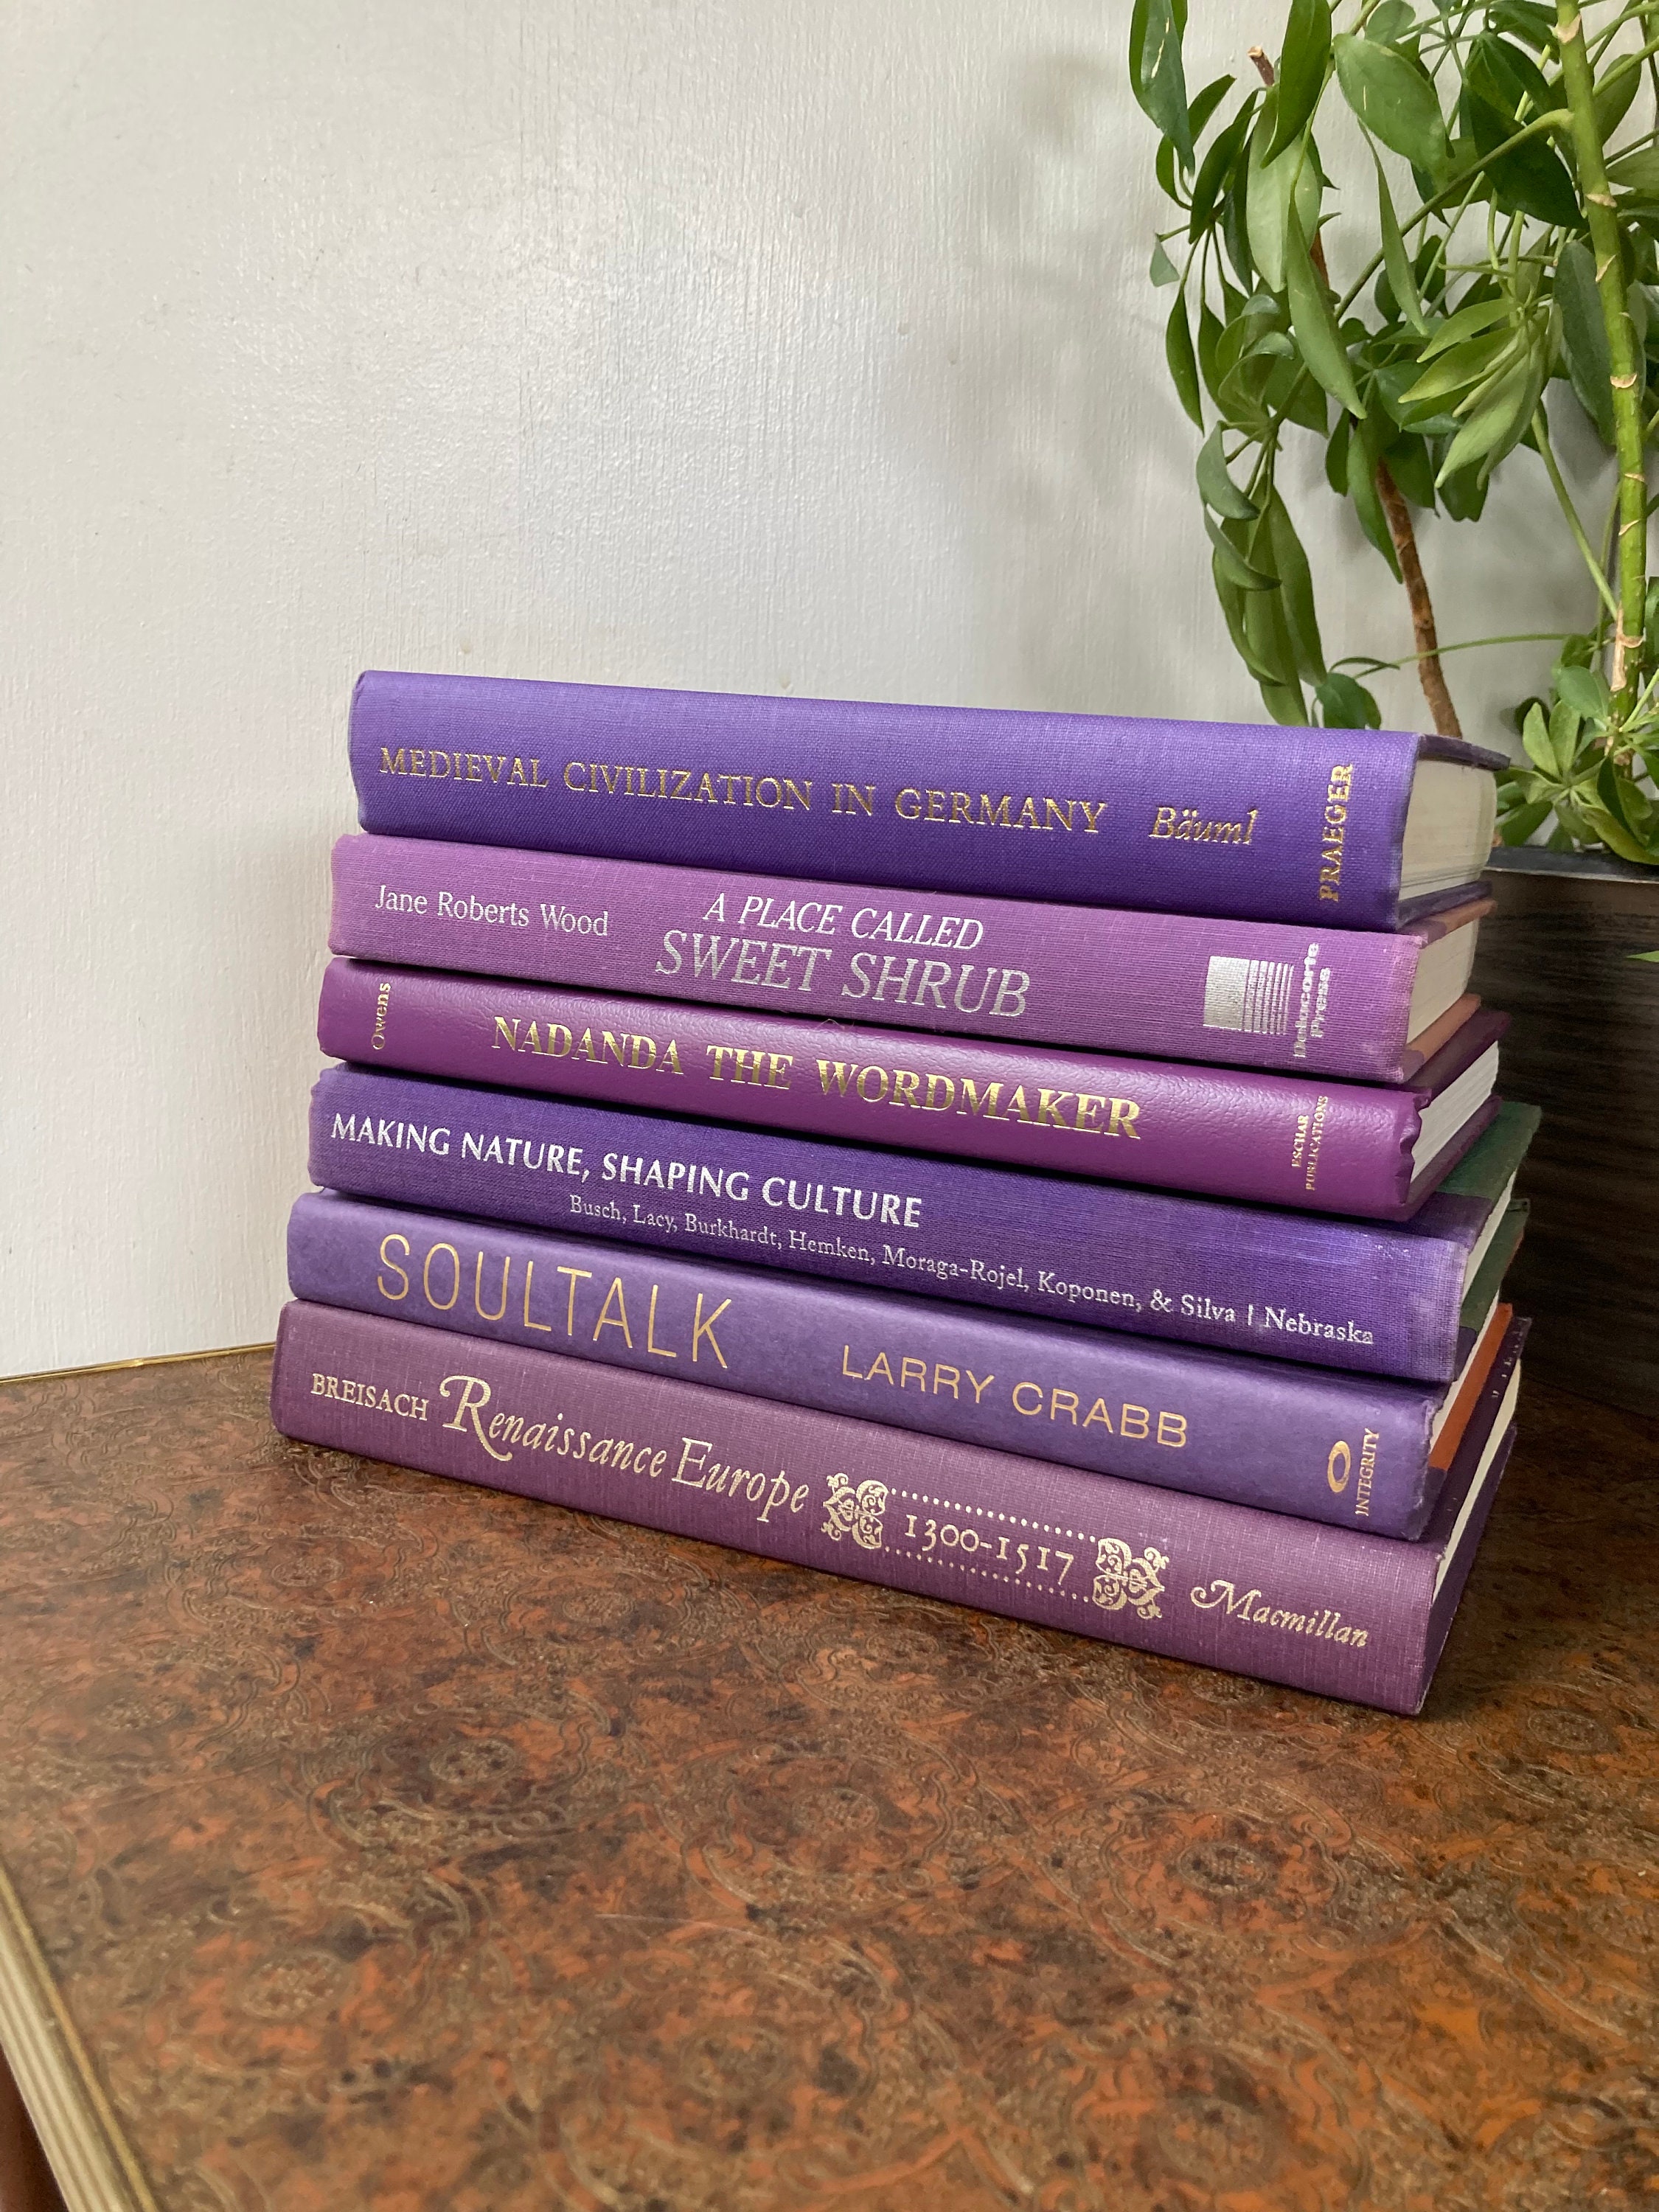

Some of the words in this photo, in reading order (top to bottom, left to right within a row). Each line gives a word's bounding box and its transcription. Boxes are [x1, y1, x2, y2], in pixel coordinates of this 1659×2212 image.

[380, 746, 549, 788] MEDIEVAL
[564, 762, 812, 812] CIVILIZATION
[832, 783, 876, 817] IN
[894, 788, 1107, 834] GERMANY
[1149, 805, 1258, 846] Bäuml
[1319, 764, 1353, 902] PRAEGER
[375, 885, 428, 915] Jane
[437, 892, 530, 928] Roberts
[540, 904, 609, 936] Wood
[703, 893, 726, 922] A
[737, 895, 844, 935] PLACE
[851, 908, 984, 951] CALLED
[372, 982, 392, 1050] Owens
[655, 930, 833, 991] SWEET
[841, 952, 1032, 1018] SHRUB
[1310, 967, 1331, 1037] Press
[491, 1016, 684, 1075] NADANDA
[706, 1045, 793, 1090] THE
[815, 1058, 1141, 1139] WORDMAKER
[330, 1113, 450, 1156] MAKING
[461, 1132, 590, 1183] NATURE,
[602, 1152, 748, 1201] SHAPING
[762, 1177, 922, 1229] CULTURE
[1292, 1115, 1309, 1167] ESCHAR
[1306, 1096, 1329, 1191] PUBLICATIONS
[377, 1234, 732, 1369] SOULTALK
[570, 1195, 627, 1224] Busch,
[633, 1204, 678, 1234] Lacy,
[685, 1213, 782, 1249] Burkhardt,
[788, 1229, 875, 1265] Hemken,
[882, 1244, 1029, 1292] Moraga-Rojel,
[1037, 1270, 1142, 1312] Koponen,
[1150, 1290, 1171, 1312] &
[1180, 1294, 1235, 1323] Silva
[1265, 1307, 1374, 1345] Nebraska
[842, 1344, 995, 1405] LARRY
[1012, 1382, 1188, 1449] CRABB
[310, 1374, 431, 1421] BREISACH
[439, 1375, 667, 1478] Renaissance
[672, 1437, 809, 1523] Europe
[1355, 1428, 1380, 1517] INTEGRITY
[904, 1514, 1074, 1586] 1300-1517
[1190, 1579, 1369, 1649] Macmillan
